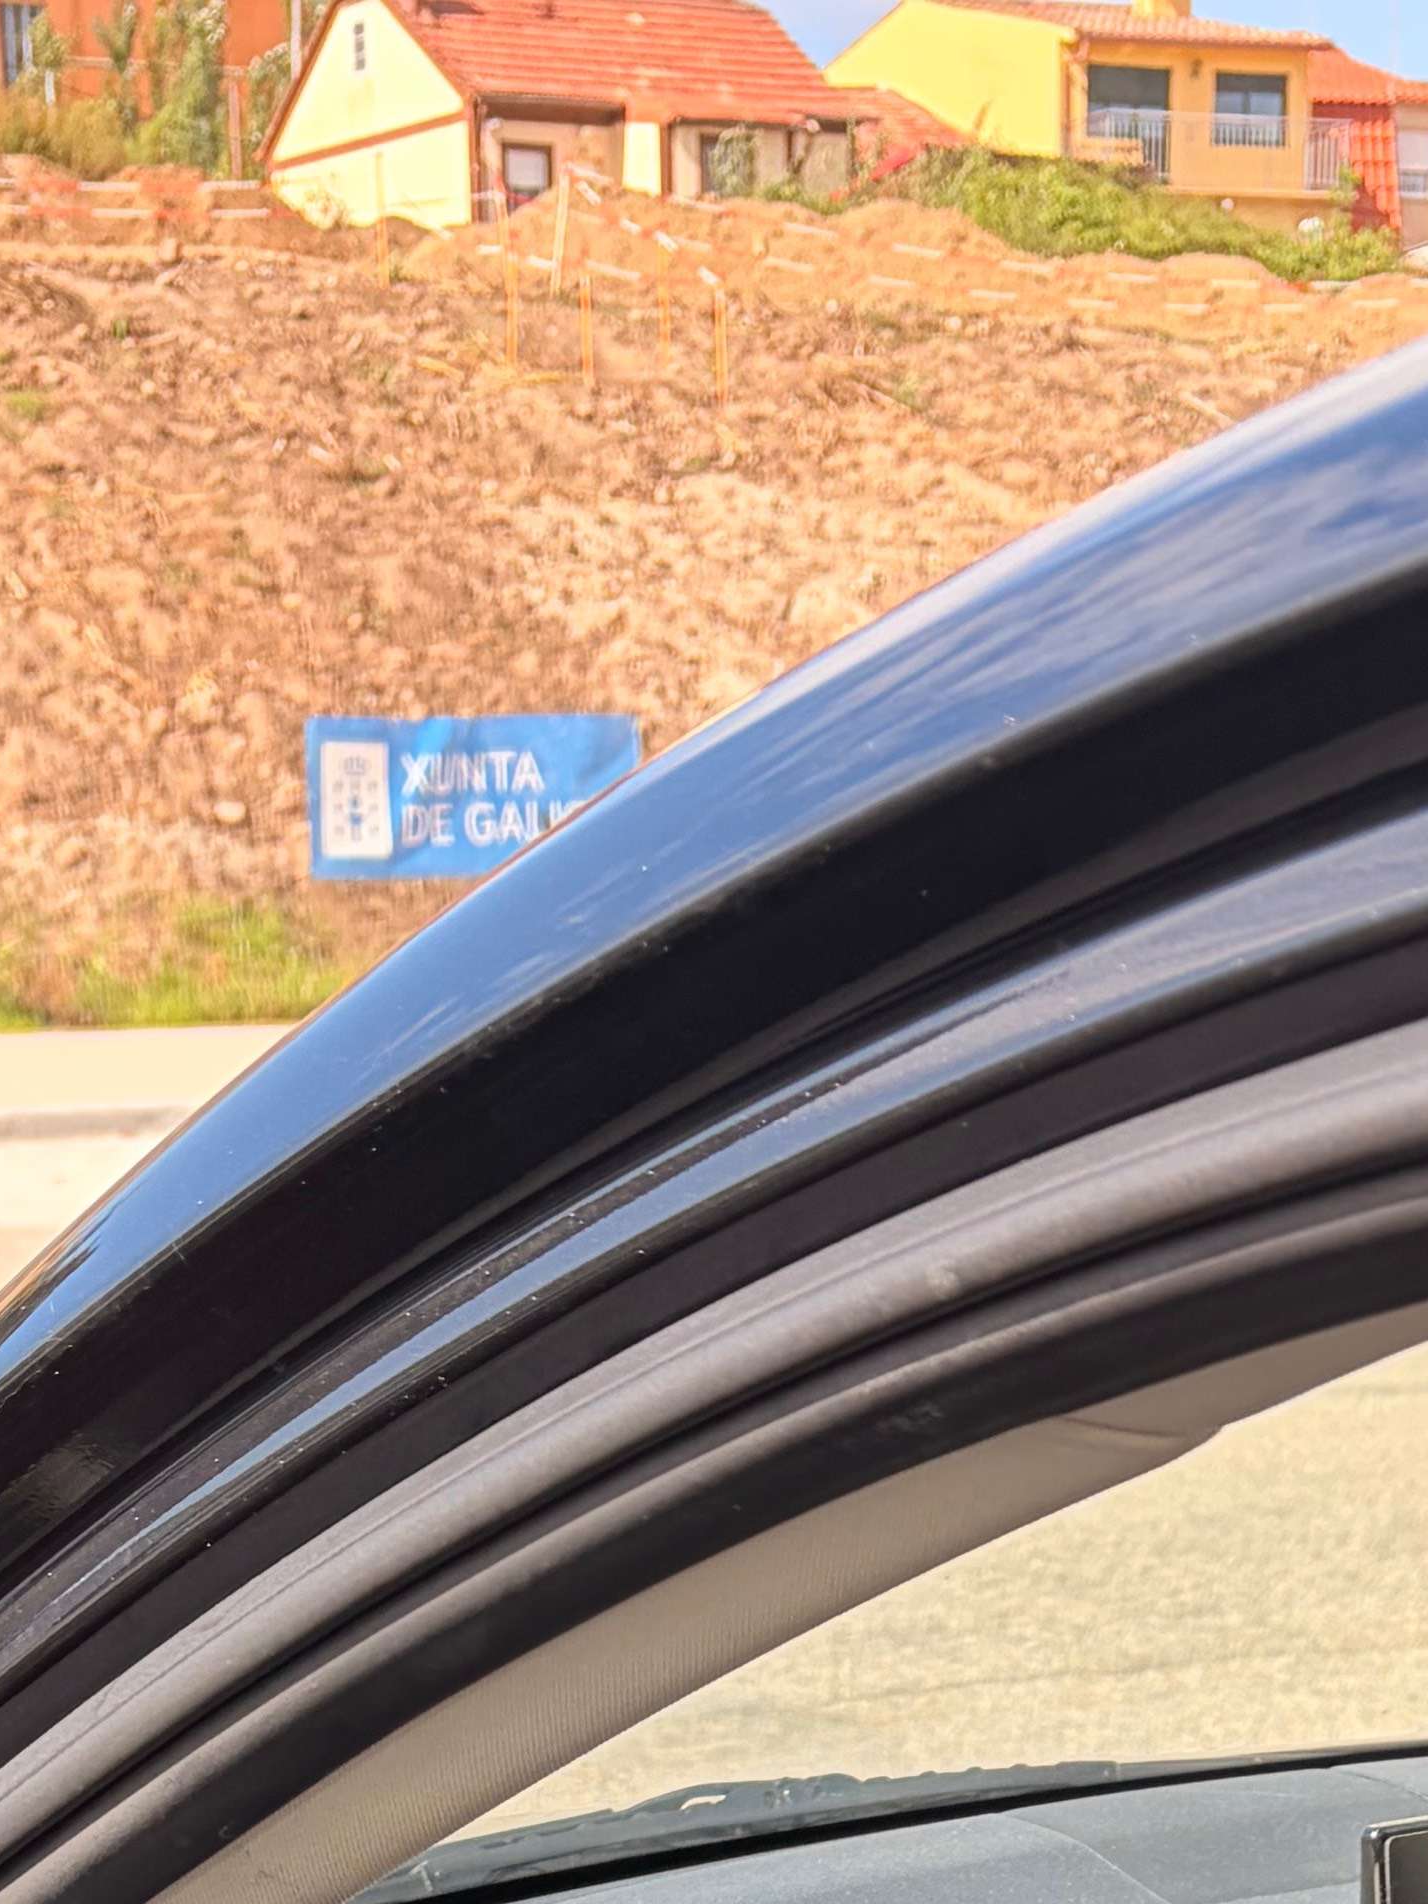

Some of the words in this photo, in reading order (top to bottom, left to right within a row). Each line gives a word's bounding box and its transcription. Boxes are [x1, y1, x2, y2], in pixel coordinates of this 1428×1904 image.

[400, 750, 546, 796] XUNTA
[401, 803, 455, 847] DE
[464, 799, 589, 847] GALI
